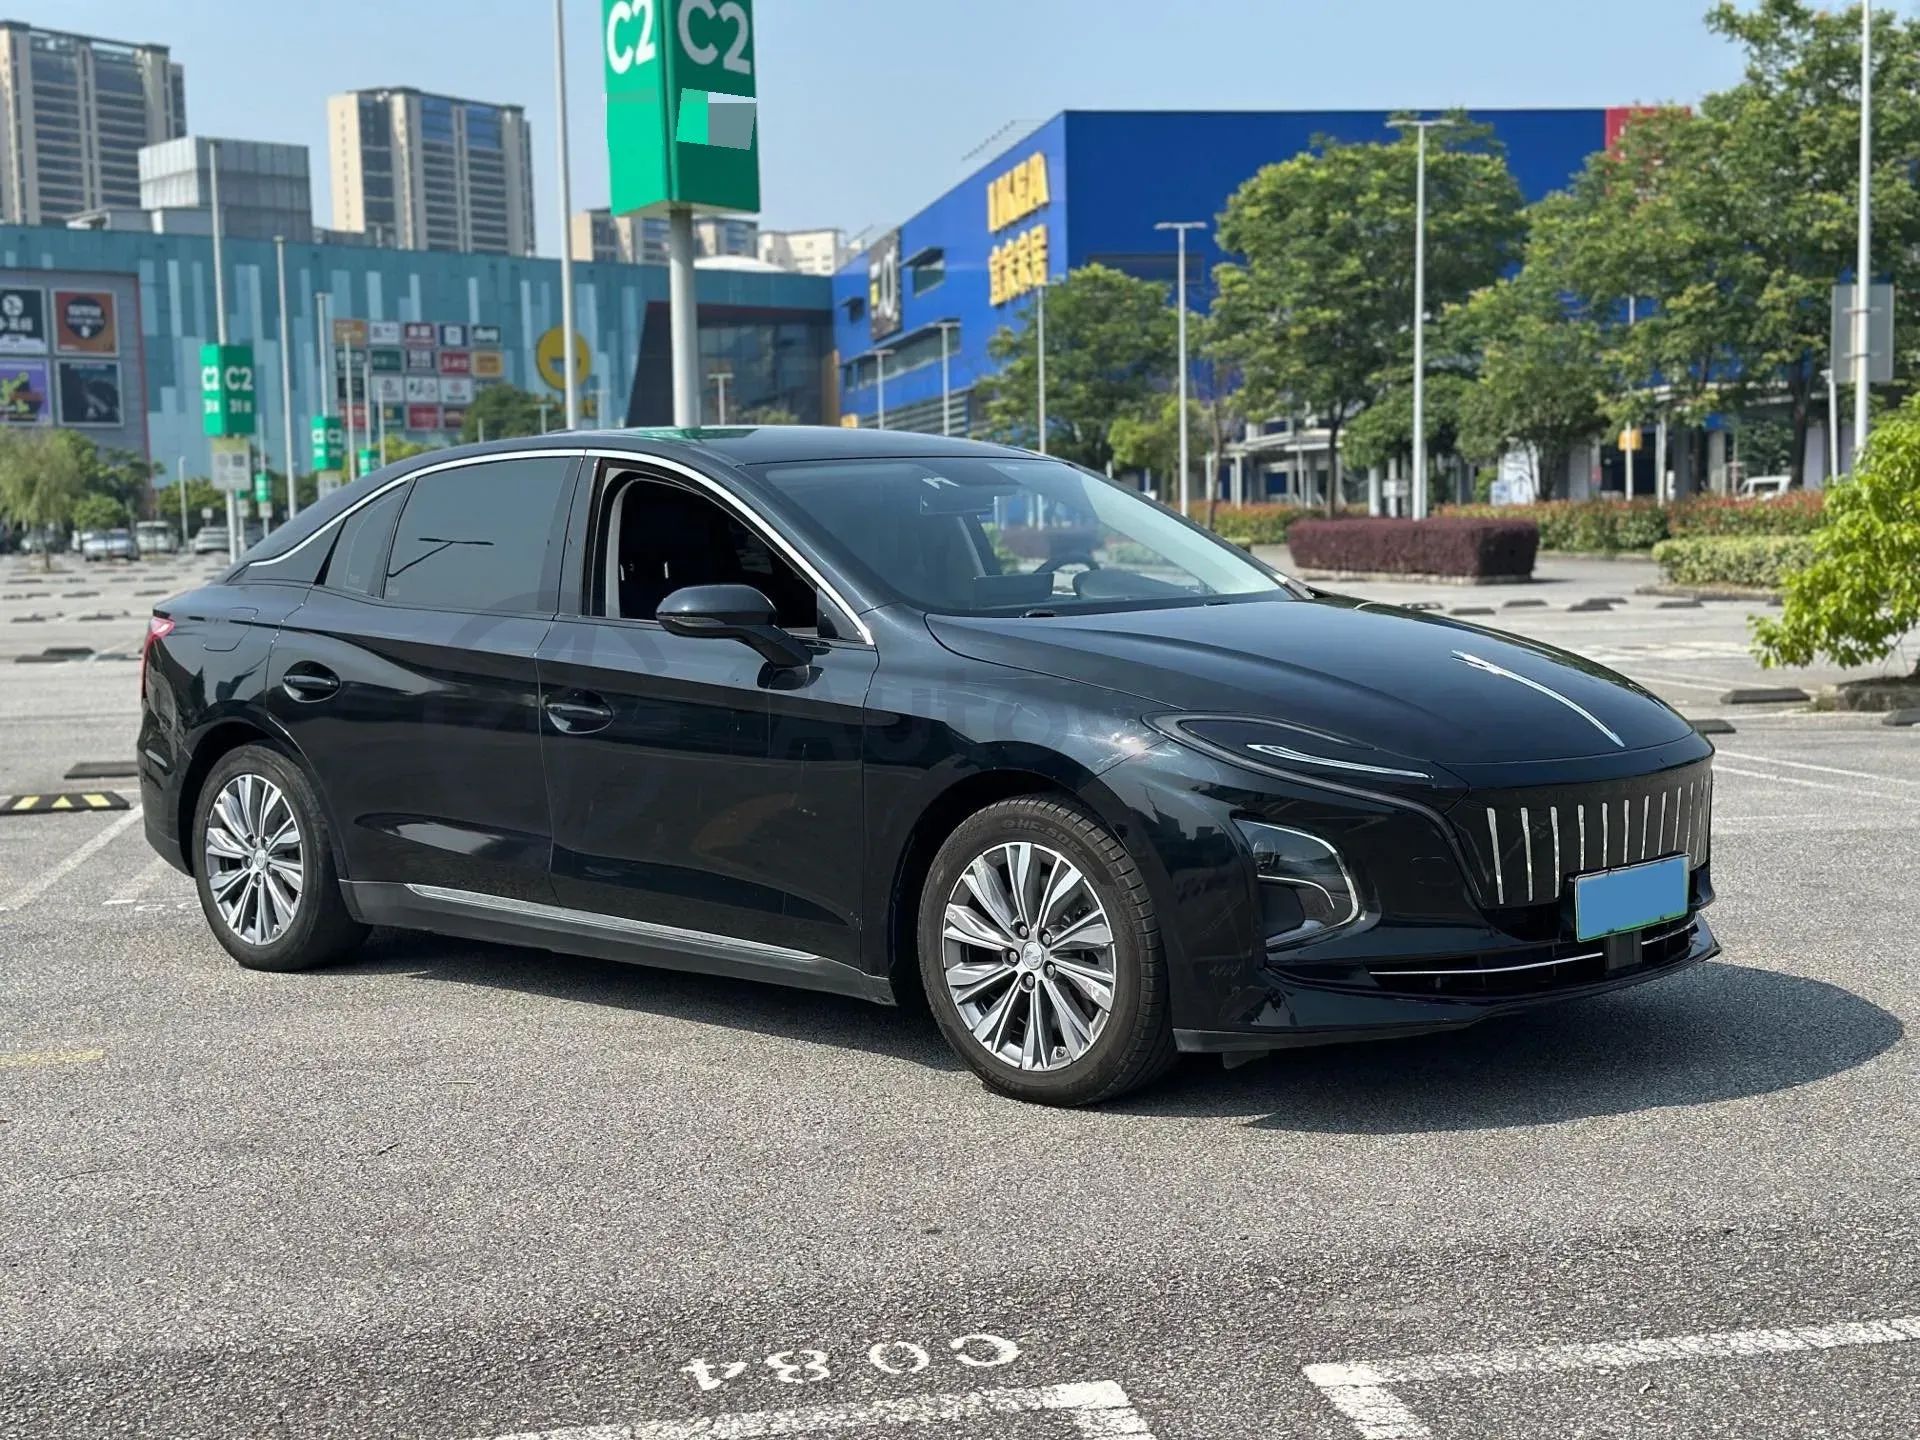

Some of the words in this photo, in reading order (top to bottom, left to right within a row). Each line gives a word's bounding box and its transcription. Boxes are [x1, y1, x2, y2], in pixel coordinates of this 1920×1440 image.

[606, 0, 656, 74] C2
[677, 0, 752, 74] C2
[224, 366, 254, 391] C2
[681, 1333, 1023, 1391] C084
